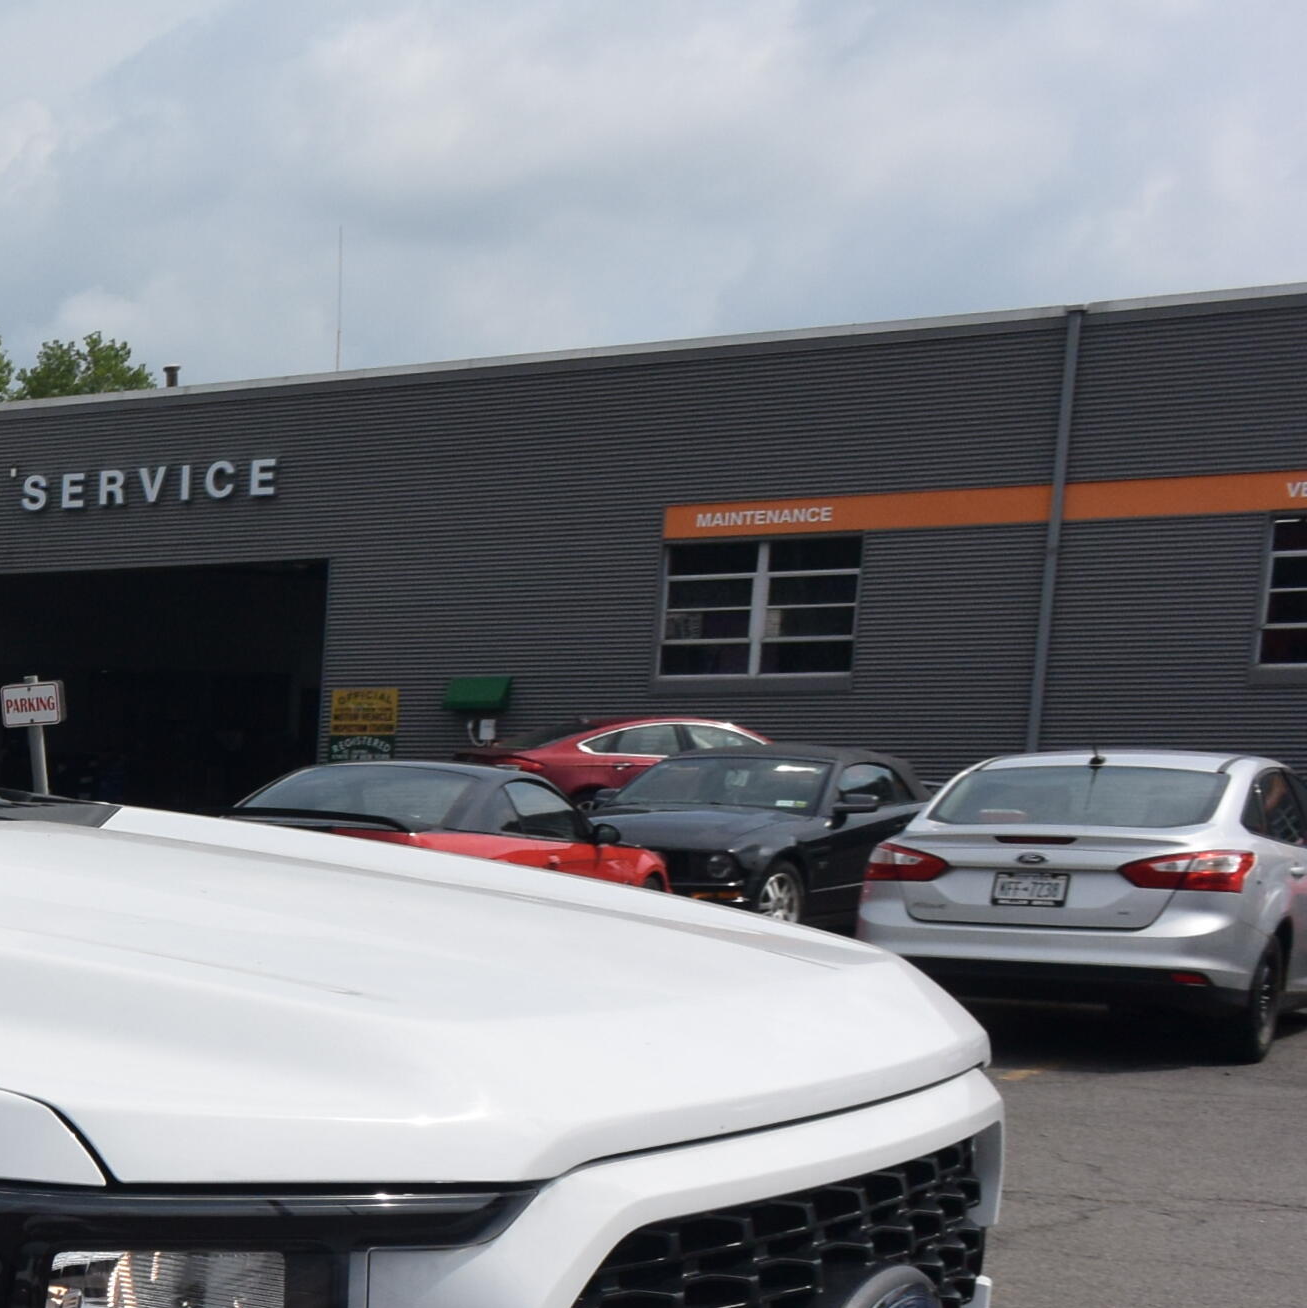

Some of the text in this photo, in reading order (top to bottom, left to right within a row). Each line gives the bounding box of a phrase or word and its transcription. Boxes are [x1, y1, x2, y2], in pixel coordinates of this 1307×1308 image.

[21, 458, 277, 511] SERVICE
[696, 506, 834, 528] MAINTENANCE
[5, 695, 56, 714] PARKING
[338, 690, 392, 705] OFFICIAL
[331, 736, 391, 753] REGISTERED
